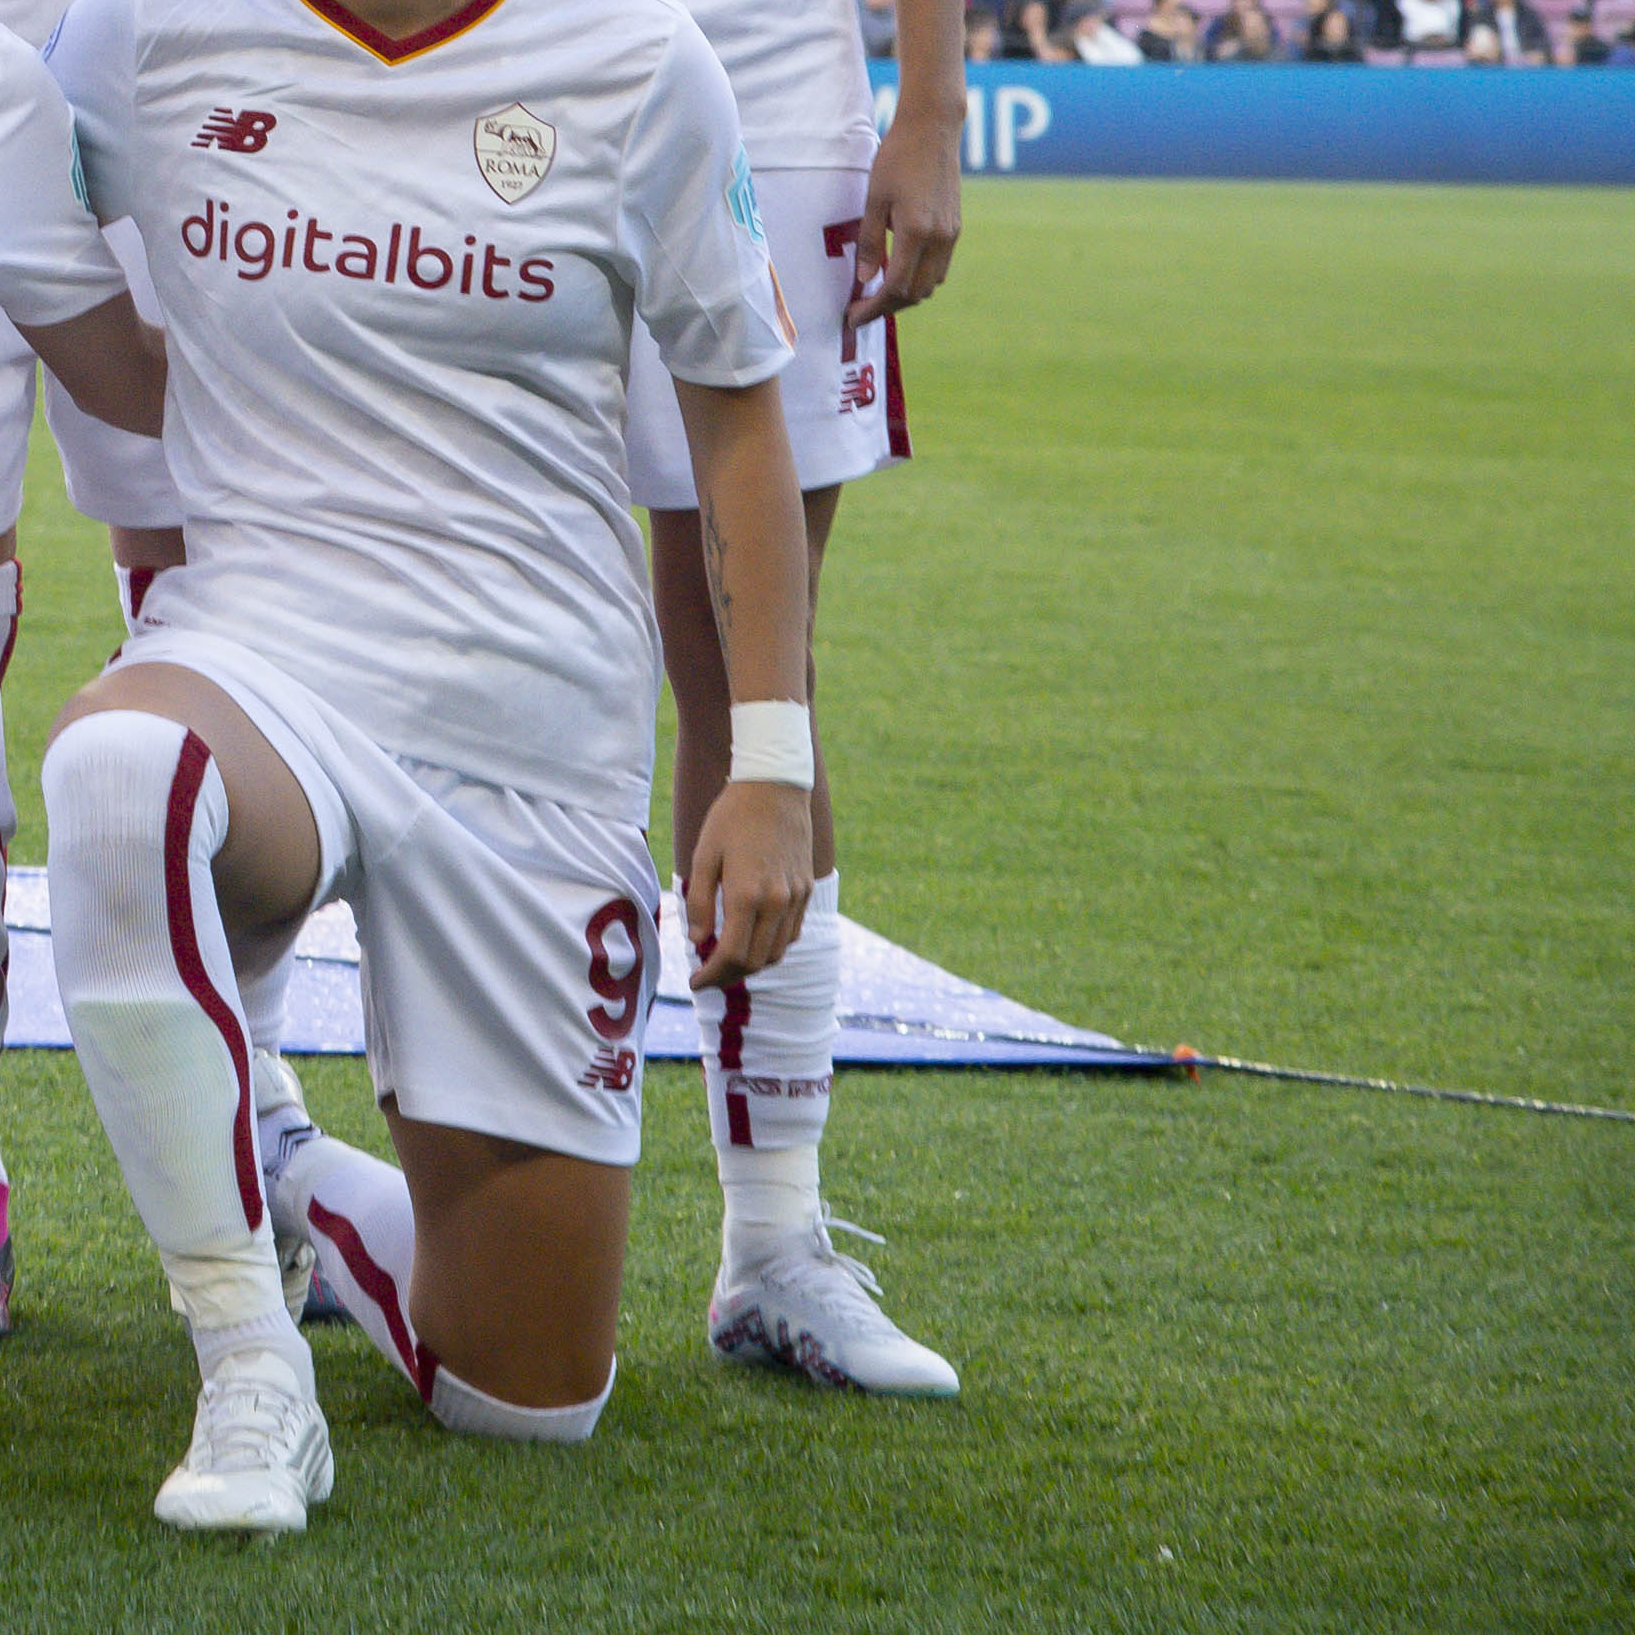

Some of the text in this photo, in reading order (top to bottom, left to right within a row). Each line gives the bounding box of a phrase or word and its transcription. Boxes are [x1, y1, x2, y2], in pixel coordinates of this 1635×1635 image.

[485, 158, 541, 180] ROMA
[180, 198, 555, 302] digitalbits
[584, 897, 644, 1040] 9
